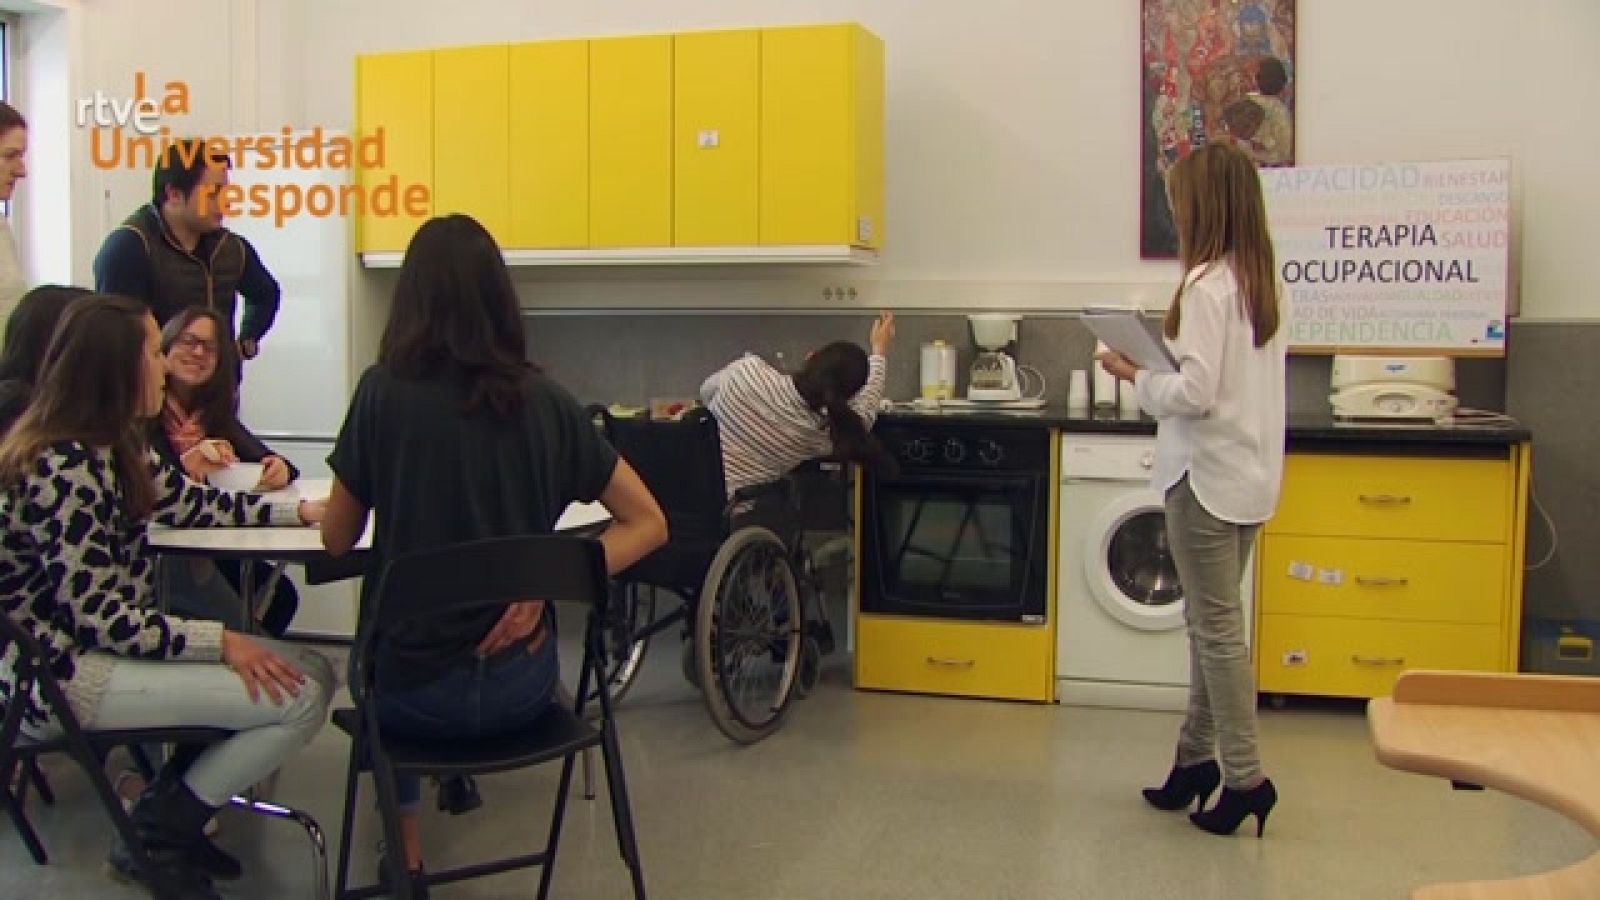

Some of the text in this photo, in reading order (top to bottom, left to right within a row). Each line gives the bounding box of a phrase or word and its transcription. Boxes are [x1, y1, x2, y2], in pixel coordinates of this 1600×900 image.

[1324, 224, 1438, 248] TERAPIA
[1441, 231, 1507, 249] SALUD
[1281, 259, 1479, 283] OCUPACIONAL
